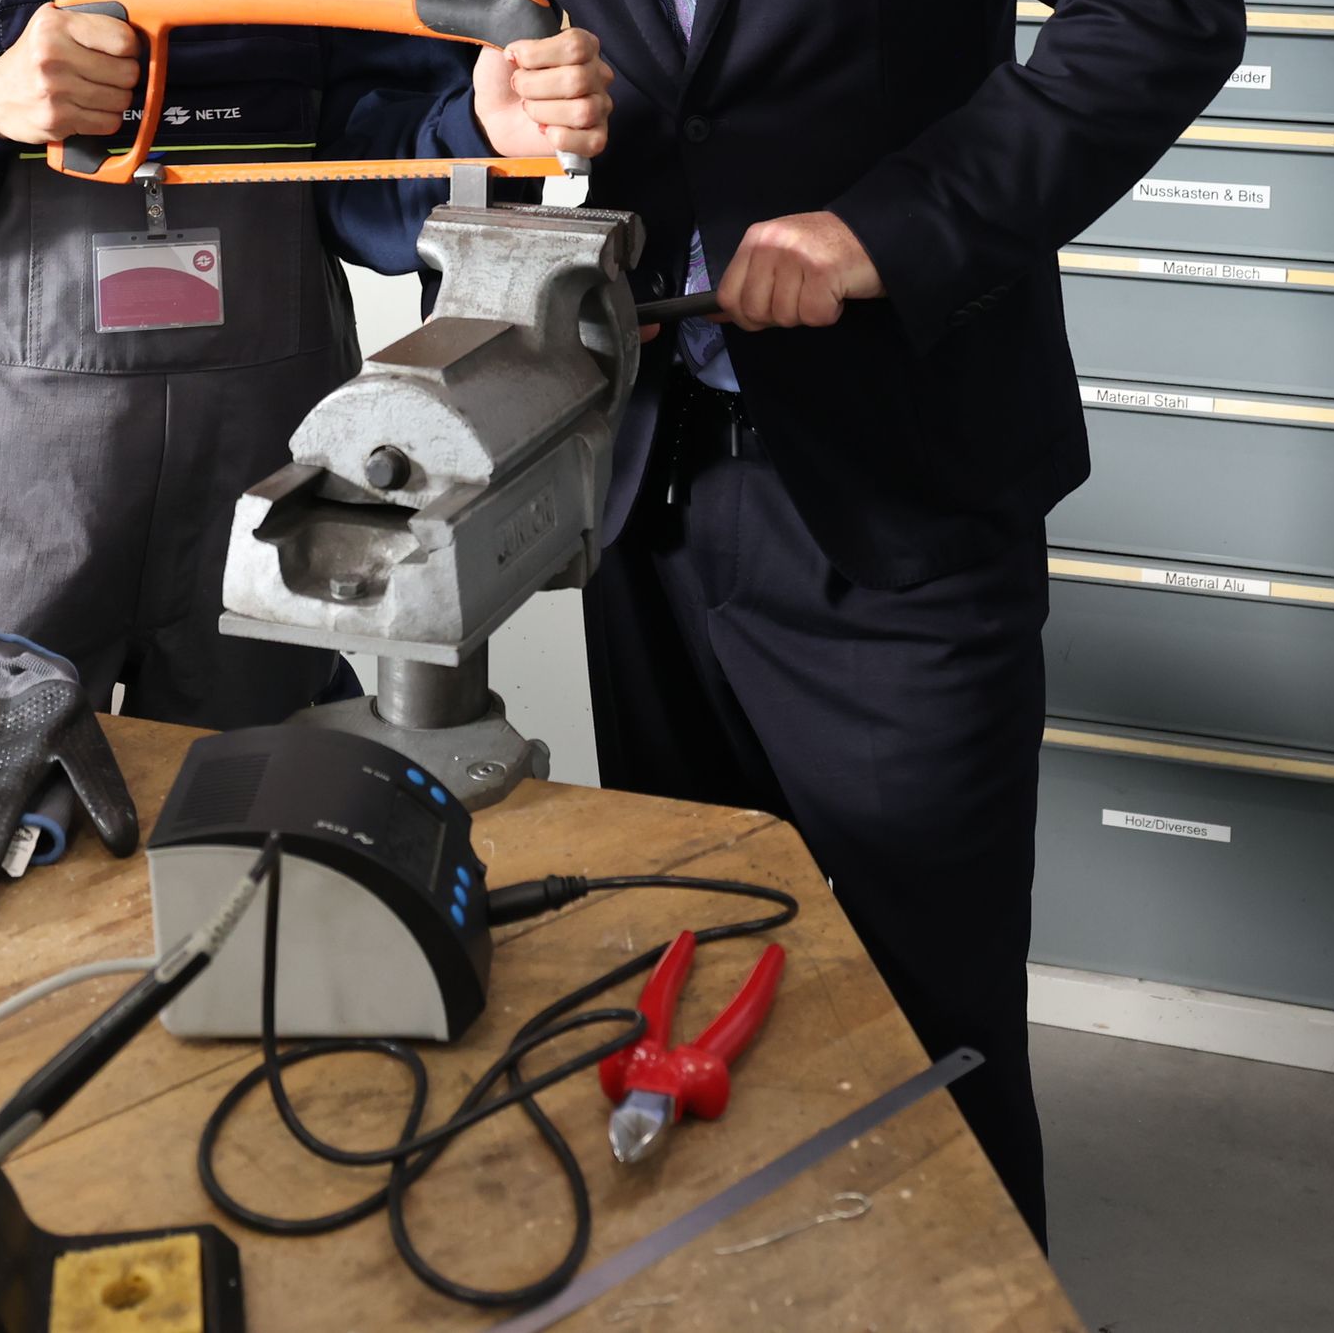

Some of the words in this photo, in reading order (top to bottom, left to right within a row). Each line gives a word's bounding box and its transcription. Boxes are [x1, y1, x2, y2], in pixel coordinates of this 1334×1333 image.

[196, 107, 241, 121] NETZE
[1139, 185, 1220, 201] Nusskasten
[1224, 190, 1234, 201] &
[1238, 190, 1263, 203] Bits
[1163, 262, 1217, 277] Material
[1222, 265, 1260, 279] Blech
[1096, 389, 1150, 405] Material
[1154, 394, 1188, 408] Stahl
[1165, 572, 1218, 589] Material
[1223, 578, 1245, 593] Alu
[1125, 815, 1208, 837] Holz/Diverses
